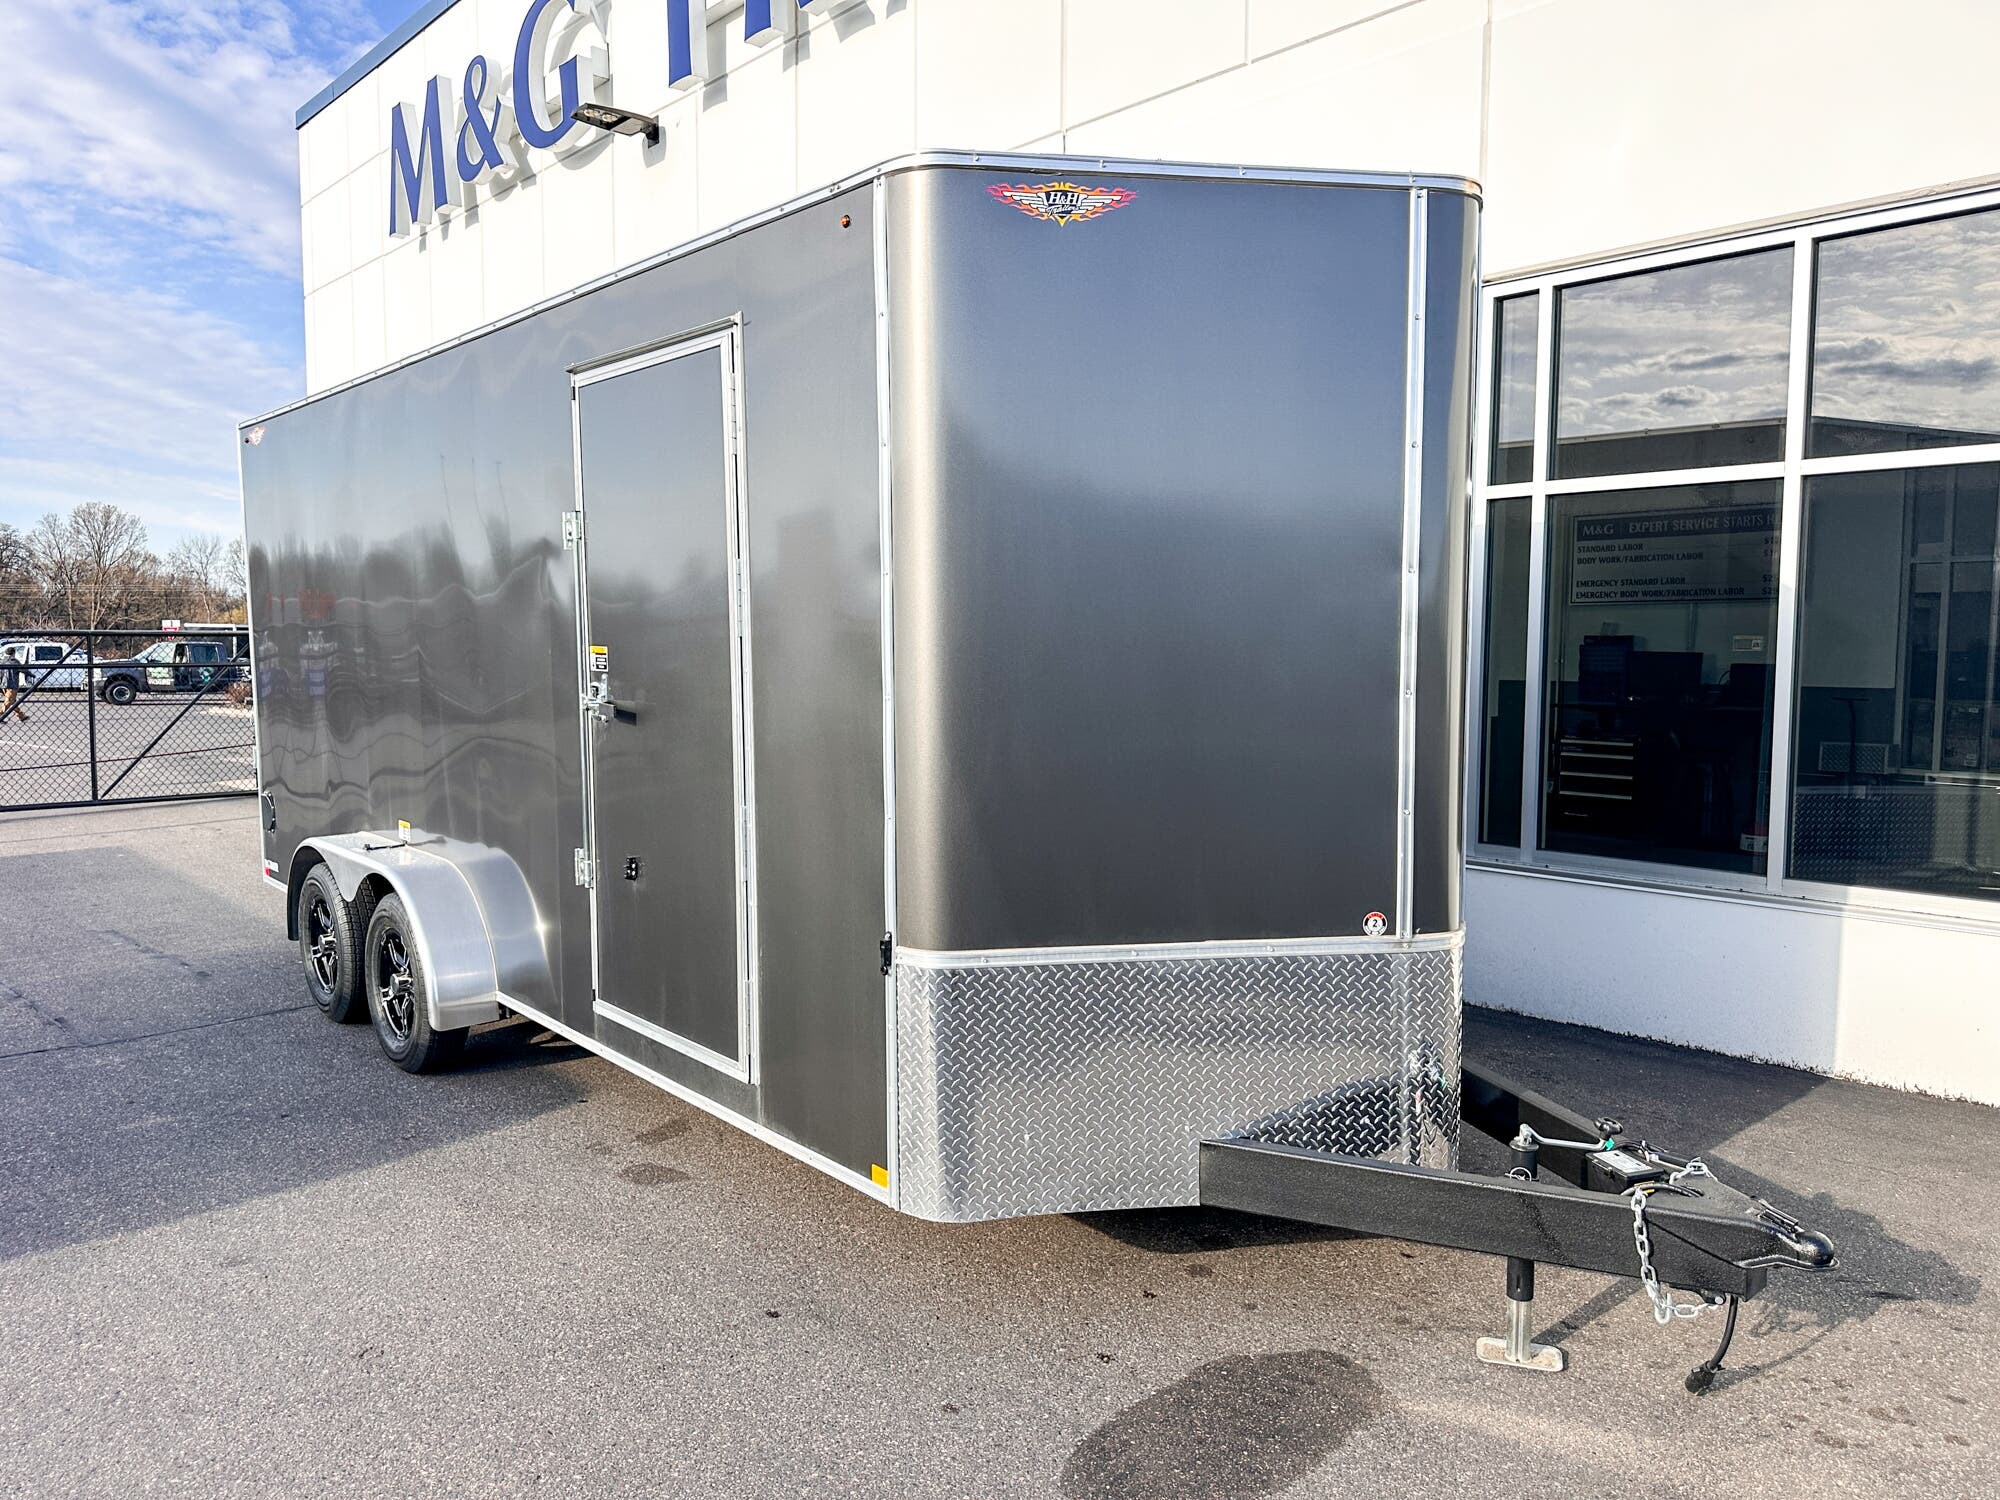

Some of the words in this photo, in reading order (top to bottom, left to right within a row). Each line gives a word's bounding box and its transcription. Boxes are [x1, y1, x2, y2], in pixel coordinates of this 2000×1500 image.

[389, 0, 611, 238] M&G
[1050, 191, 1080, 205] H&H
[1582, 523, 1615, 537] M&G
[1629, 520, 1669, 534] EXPERT
[1672, 516, 1720, 531] SERVICE
[1723, 513, 1764, 528] STARTS
[1577, 544, 1616, 554] STANDARD
[1618, 543, 1644, 552] LABOR
[1577, 556, 1597, 565] BODY
[1599, 552, 1674, 564] WORK/FABRICATION
[1676, 551, 1704, 561] LABOR
[1576, 579, 1618, 588] EMERGENCY
[1620, 578, 1658, 587] STANDARD
[1660, 576, 1686, 585] LABOR
[1576, 590, 1618, 599] EMERGENCY
[1620, 589, 1640, 598] BODY
[1641, 587, 1717, 598] WORK/FABRICATION
[1718, 586, 1745, 596] LABOR
[1371, 918, 1379, 928] 2
